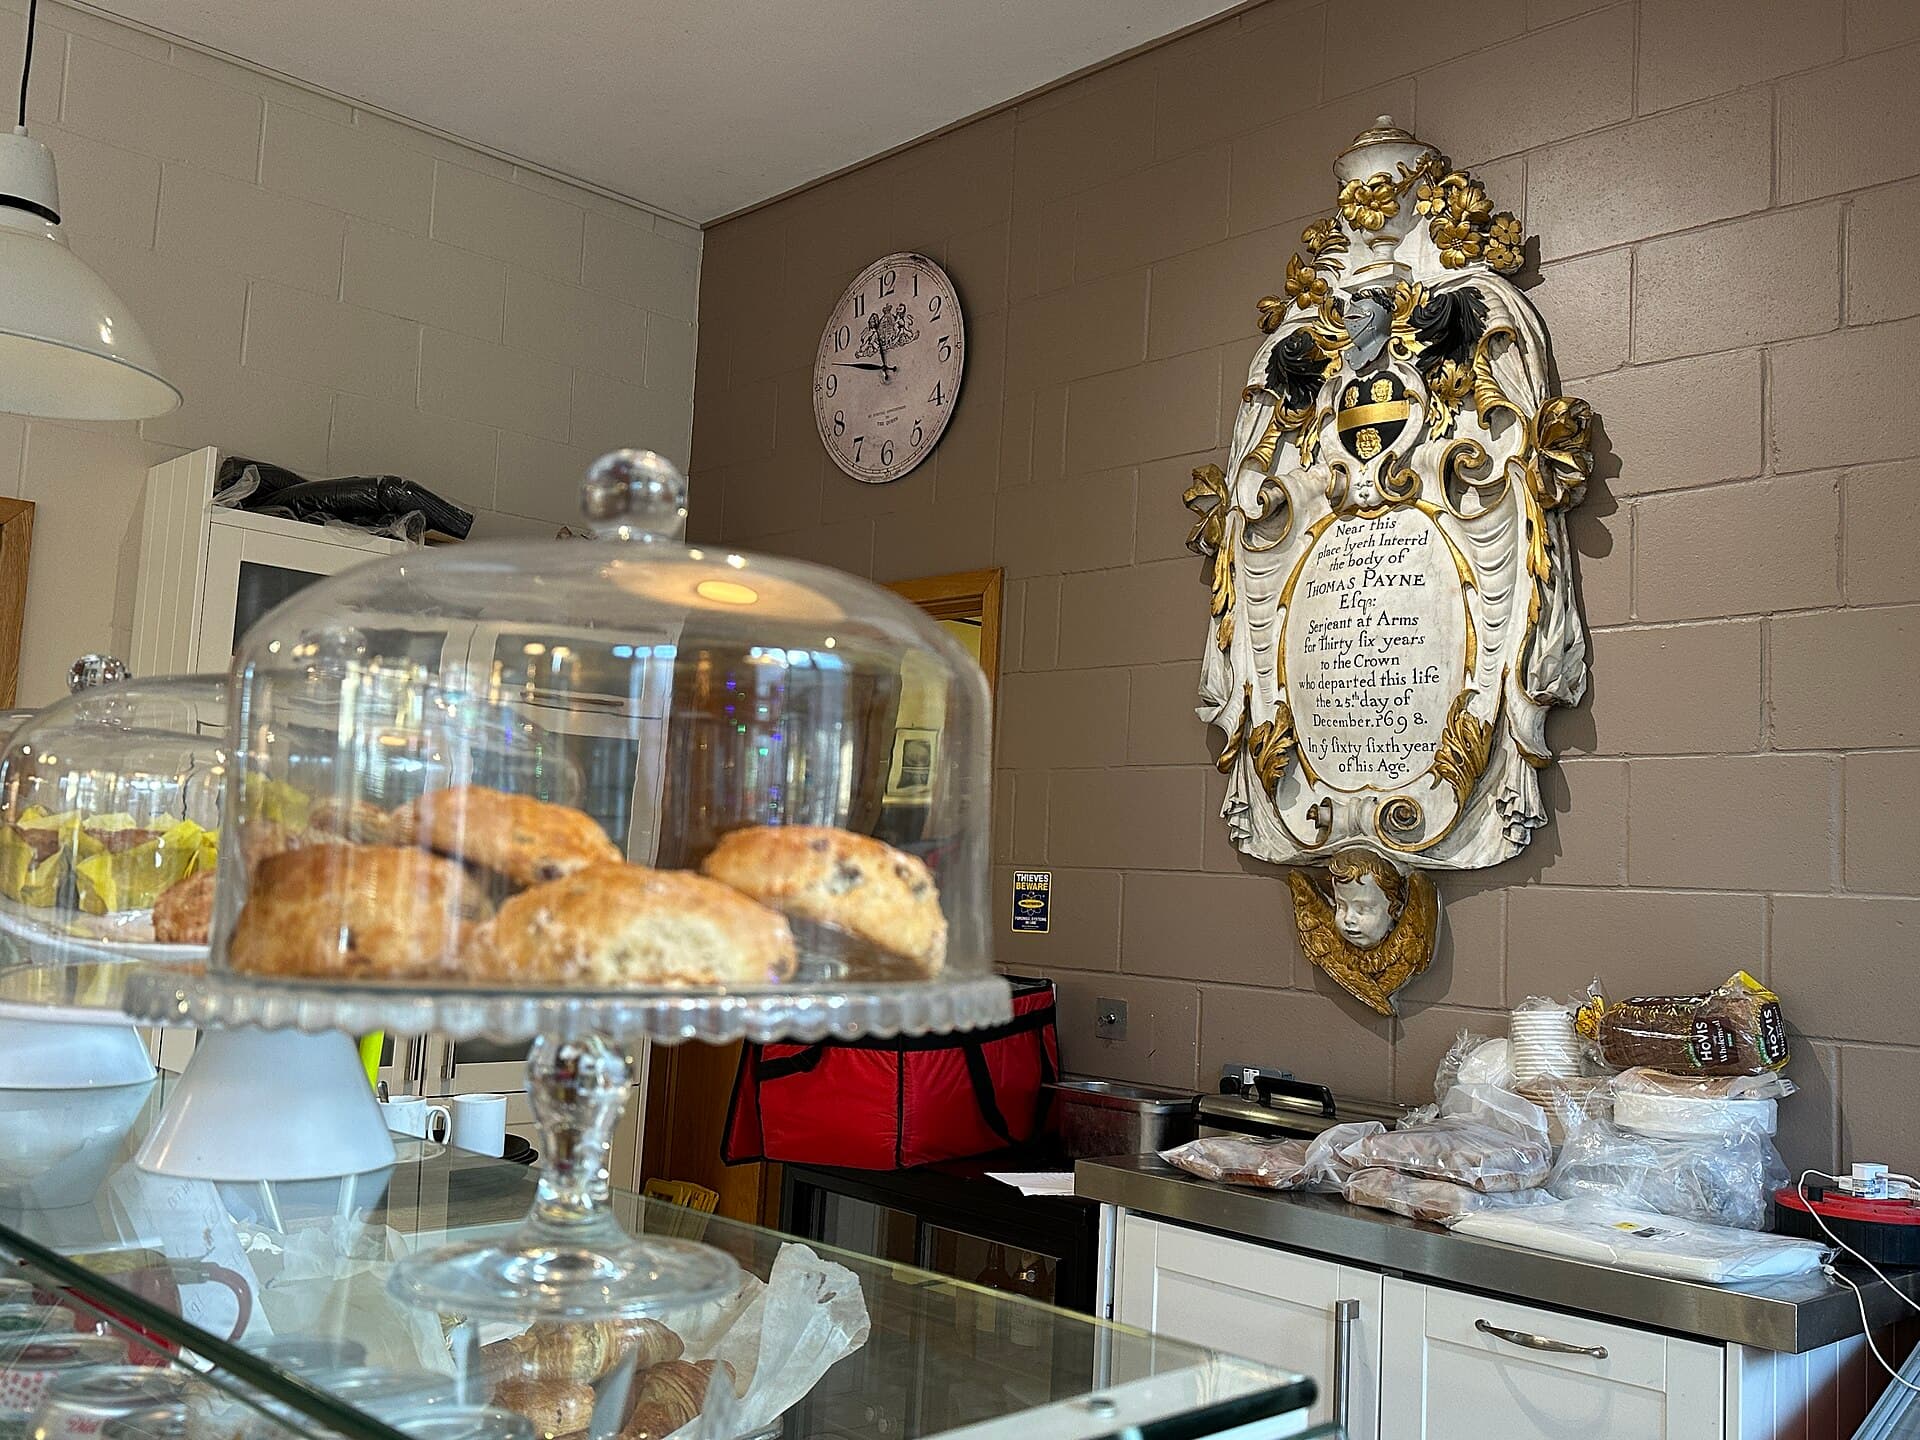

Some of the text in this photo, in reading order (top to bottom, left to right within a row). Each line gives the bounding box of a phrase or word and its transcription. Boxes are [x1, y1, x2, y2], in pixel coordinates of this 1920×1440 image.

[878, 270, 896, 299] 12
[912, 273, 918, 298] 1
[853, 292, 865, 318] 11
[929, 295, 942, 322] 2
[833, 325, 851, 353] 10
[937, 335, 952, 363] 3
[825, 374, 838, 398] 9
[927, 379, 946, 407] 4
[833, 410, 846, 437] 8
[909, 418, 923, 447] 5
[853, 436, 865, 463] 7
[880, 439, 894, 466] 6
[1336, 517, 1397, 537] Near this
[1317, 544, 1341, 565] place
[1343, 534, 1375, 556] lyeth
[1329, 548, 1410, 571] the body of
[1306, 569, 1425, 598] THOMAS PAYNE
[1308, 610, 1419, 637] Serjeant at Arms
[1304, 636, 1316, 653] for
[1318, 636, 1353, 656] Thirty
[1377, 635, 1426, 653] years
[1320, 653, 1401, 670] to the Crown
[1299, 665, 1440, 694] who departed this life
[1316, 693, 1331, 708] the
[1360, 689, 1390, 714] day
[1393, 688, 1414, 707] of
[1307, 737, 1318, 753] In
[1400, 742, 1437, 760] year
[1338, 756, 1410, 779] of his Age.
[1016, 874, 1049, 882] THIEVES
[1016, 882, 1048, 890] BEWARE
[1695, 1022, 1713, 1061] HOVIS
[1712, 1019, 1728, 1062] Wholemeal
[1764, 1009, 1779, 1057] HOVIS
